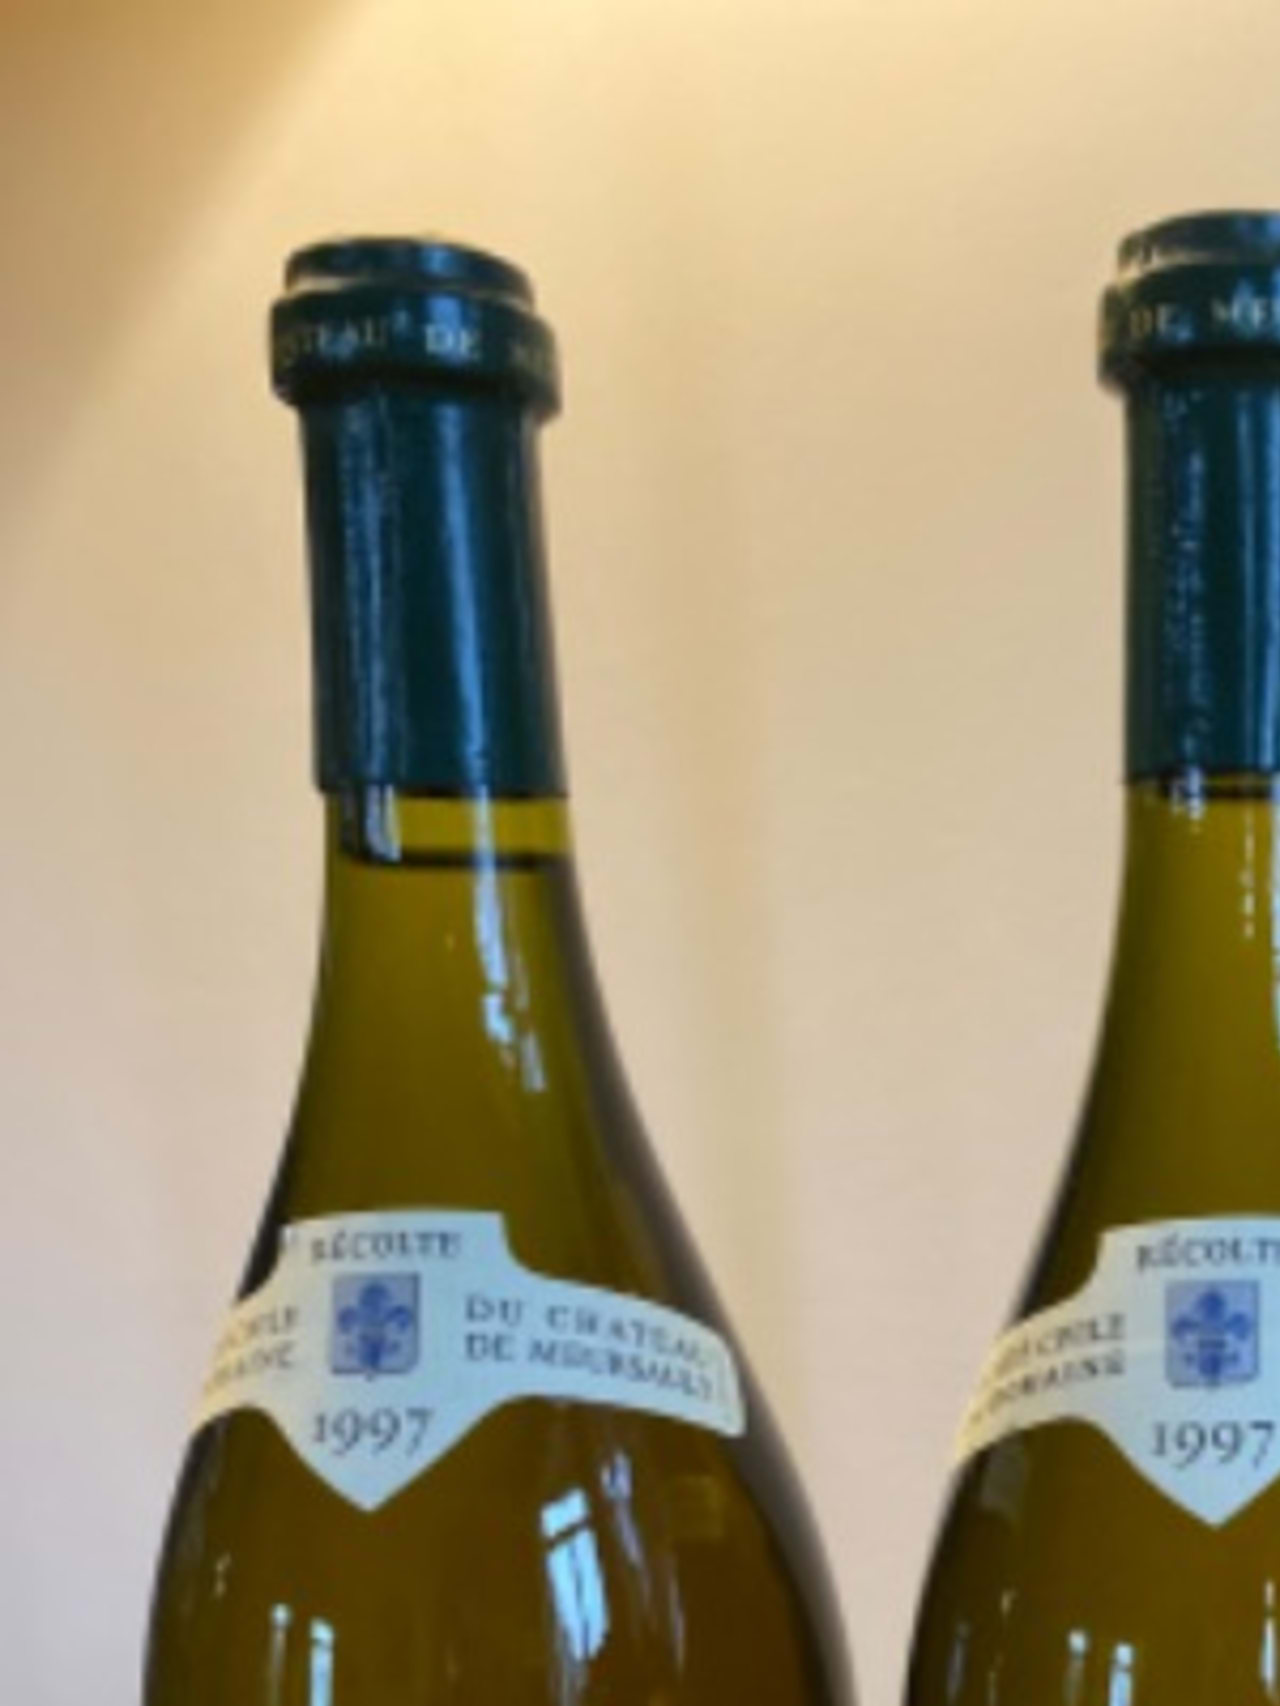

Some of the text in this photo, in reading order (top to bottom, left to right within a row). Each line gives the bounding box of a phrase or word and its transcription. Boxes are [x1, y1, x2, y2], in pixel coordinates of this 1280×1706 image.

[311, 1228, 463, 1264] RÉCOLTE
[466, 1296, 523, 1327] DU
[466, 1332, 517, 1363] DE
[312, 1405, 436, 1457] 1997
[1150, 1420, 1277, 1471] 1997
